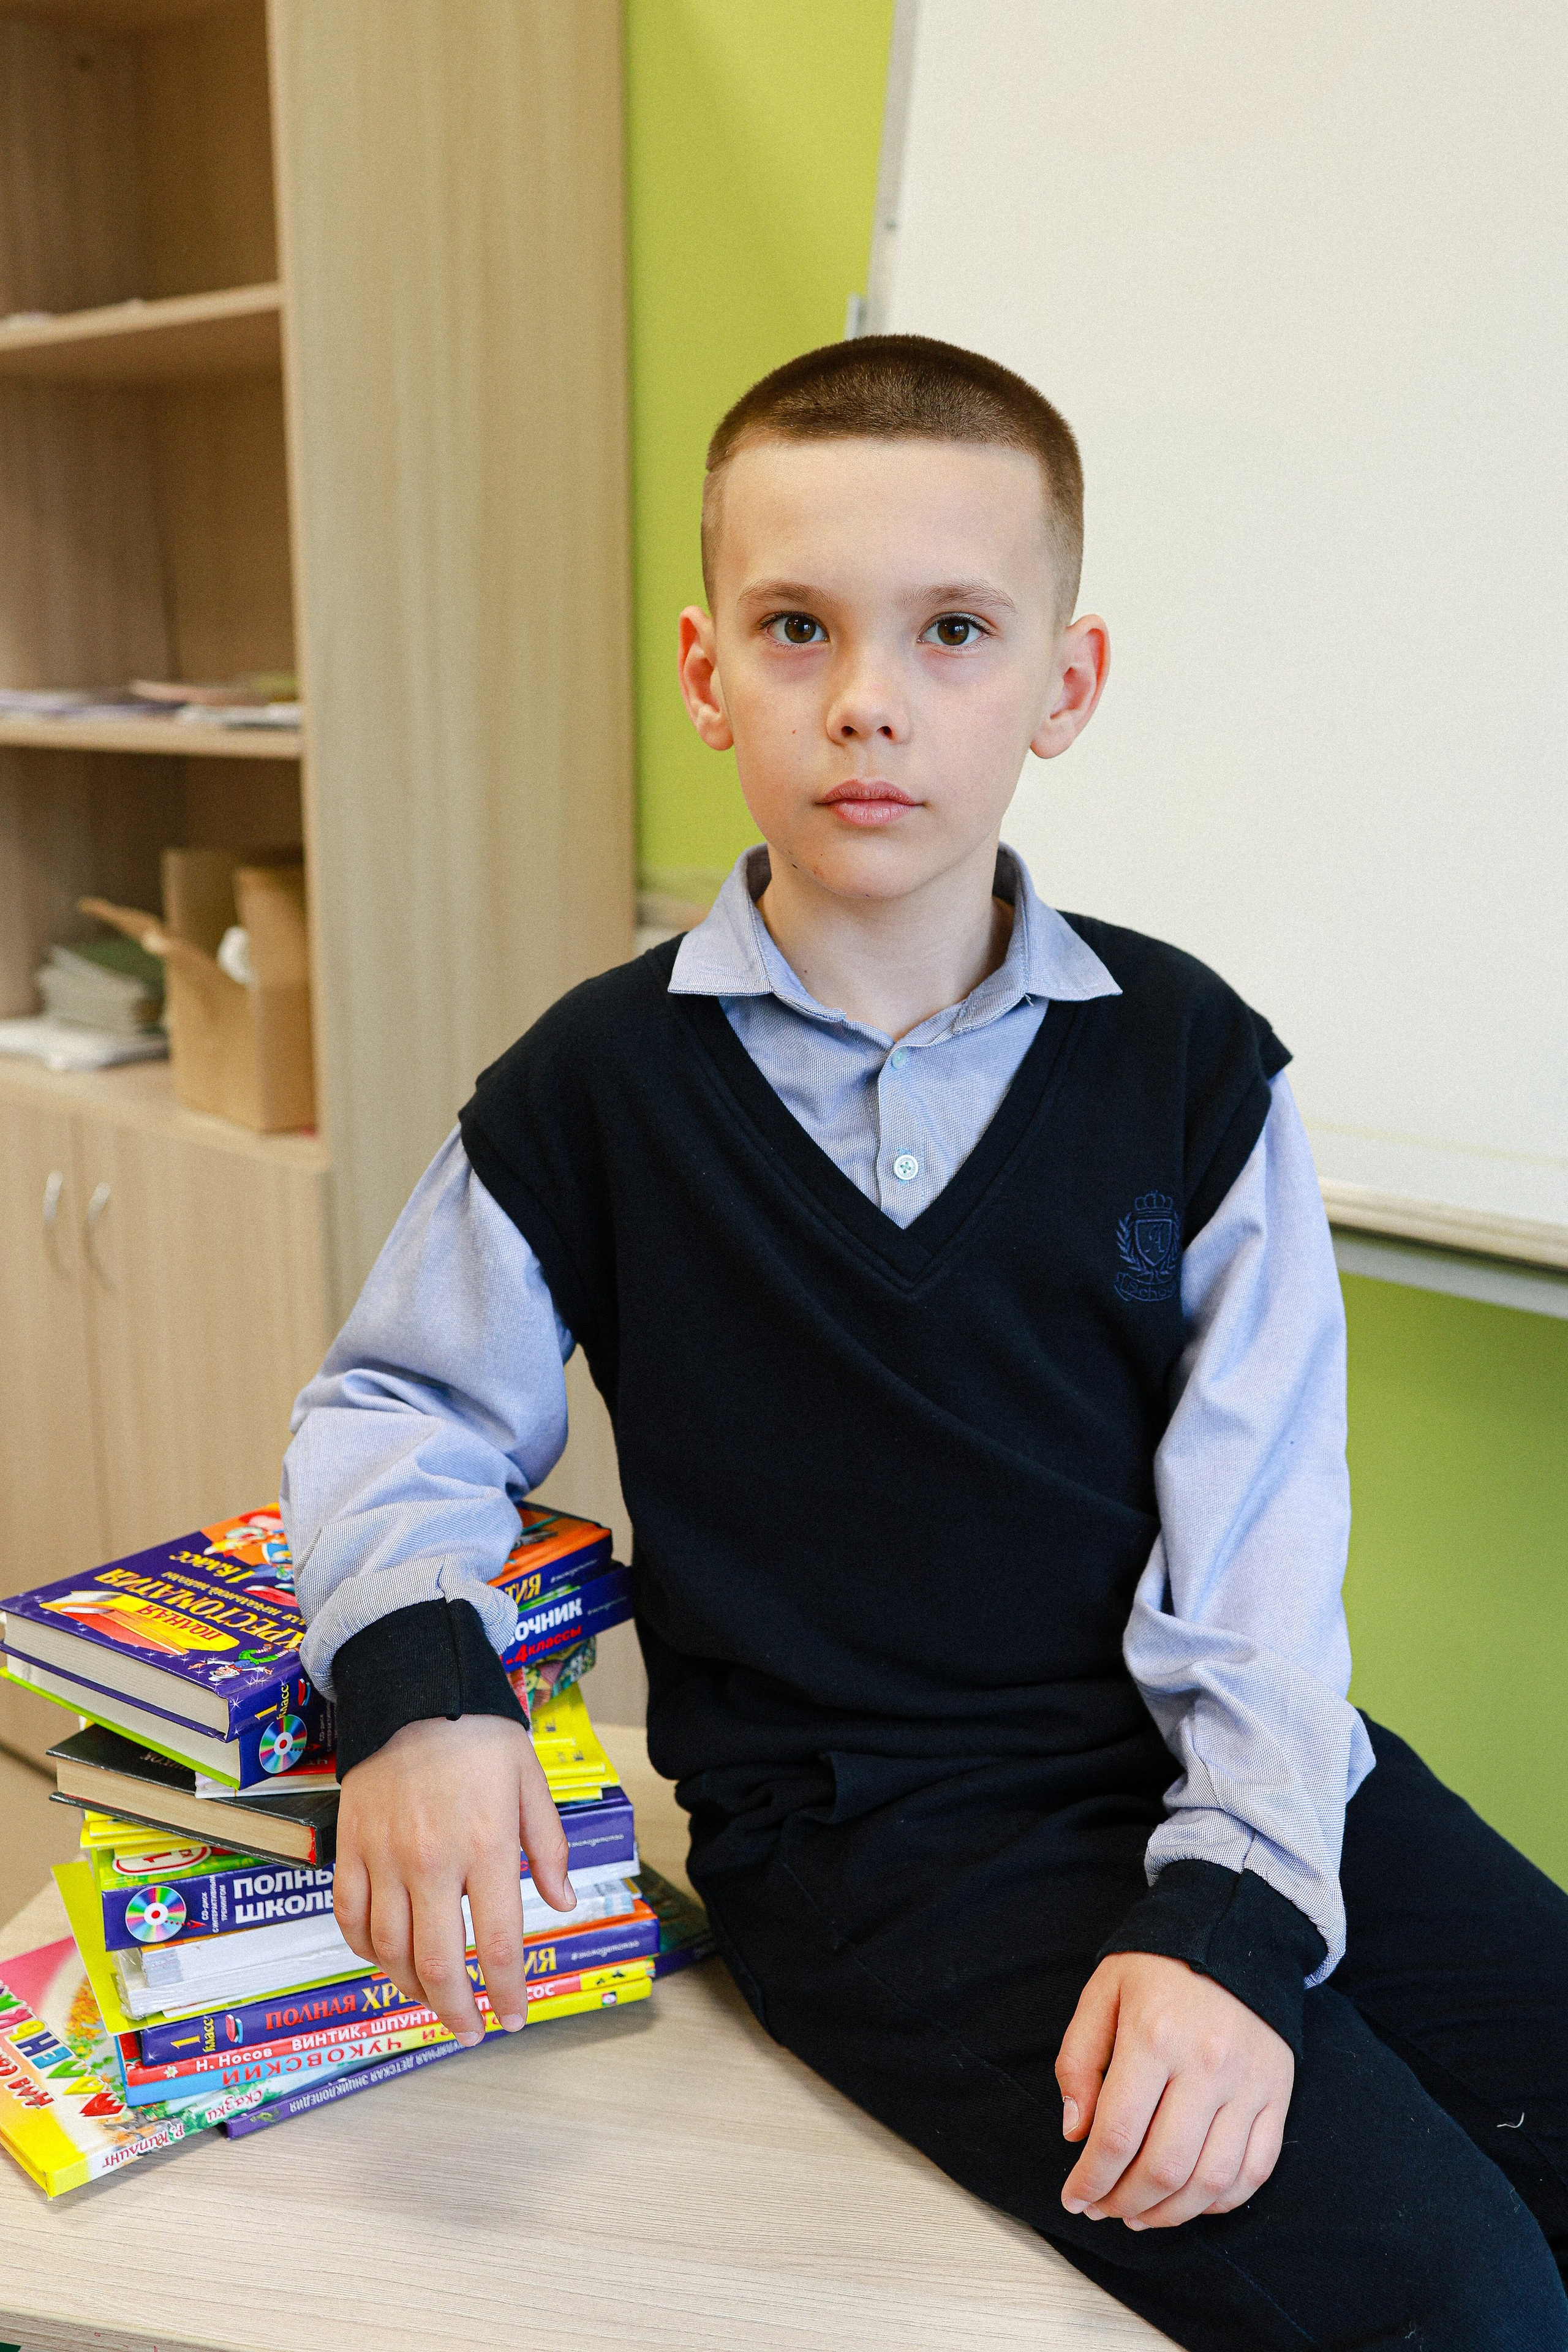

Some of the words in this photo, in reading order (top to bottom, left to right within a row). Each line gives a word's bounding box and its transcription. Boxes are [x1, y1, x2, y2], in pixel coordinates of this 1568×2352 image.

[94, 1567, 306, 1650] ХРЕСТОМАТИЯ
[136, 1604, 224, 1641] ПОЛНАЯ
[508, 1597, 583, 1647] ОЧНИК
[233, 1863, 336, 1899] ПОЛНЫ
[235, 1889, 334, 1924] ШКОЛЬ
[265, 1994, 357, 2030] ПОЛНАЯ
[170, 2034, 201, 2050] 1
[195, 2059, 215, 2072] Н.
[218, 2048, 273, 2068] Носов
[292, 2025, 368, 2052] ВИНТИК,
[371, 2010, 439, 2034] ШПУНТ
[222, 2037, 402, 2088] ЧУКОВСКИЙ
[369, 2055, 414, 2082] ДЕТСКАЯ
[288, 2075, 369, 2113] ЭНЦИКЛОПЕДИЯ
